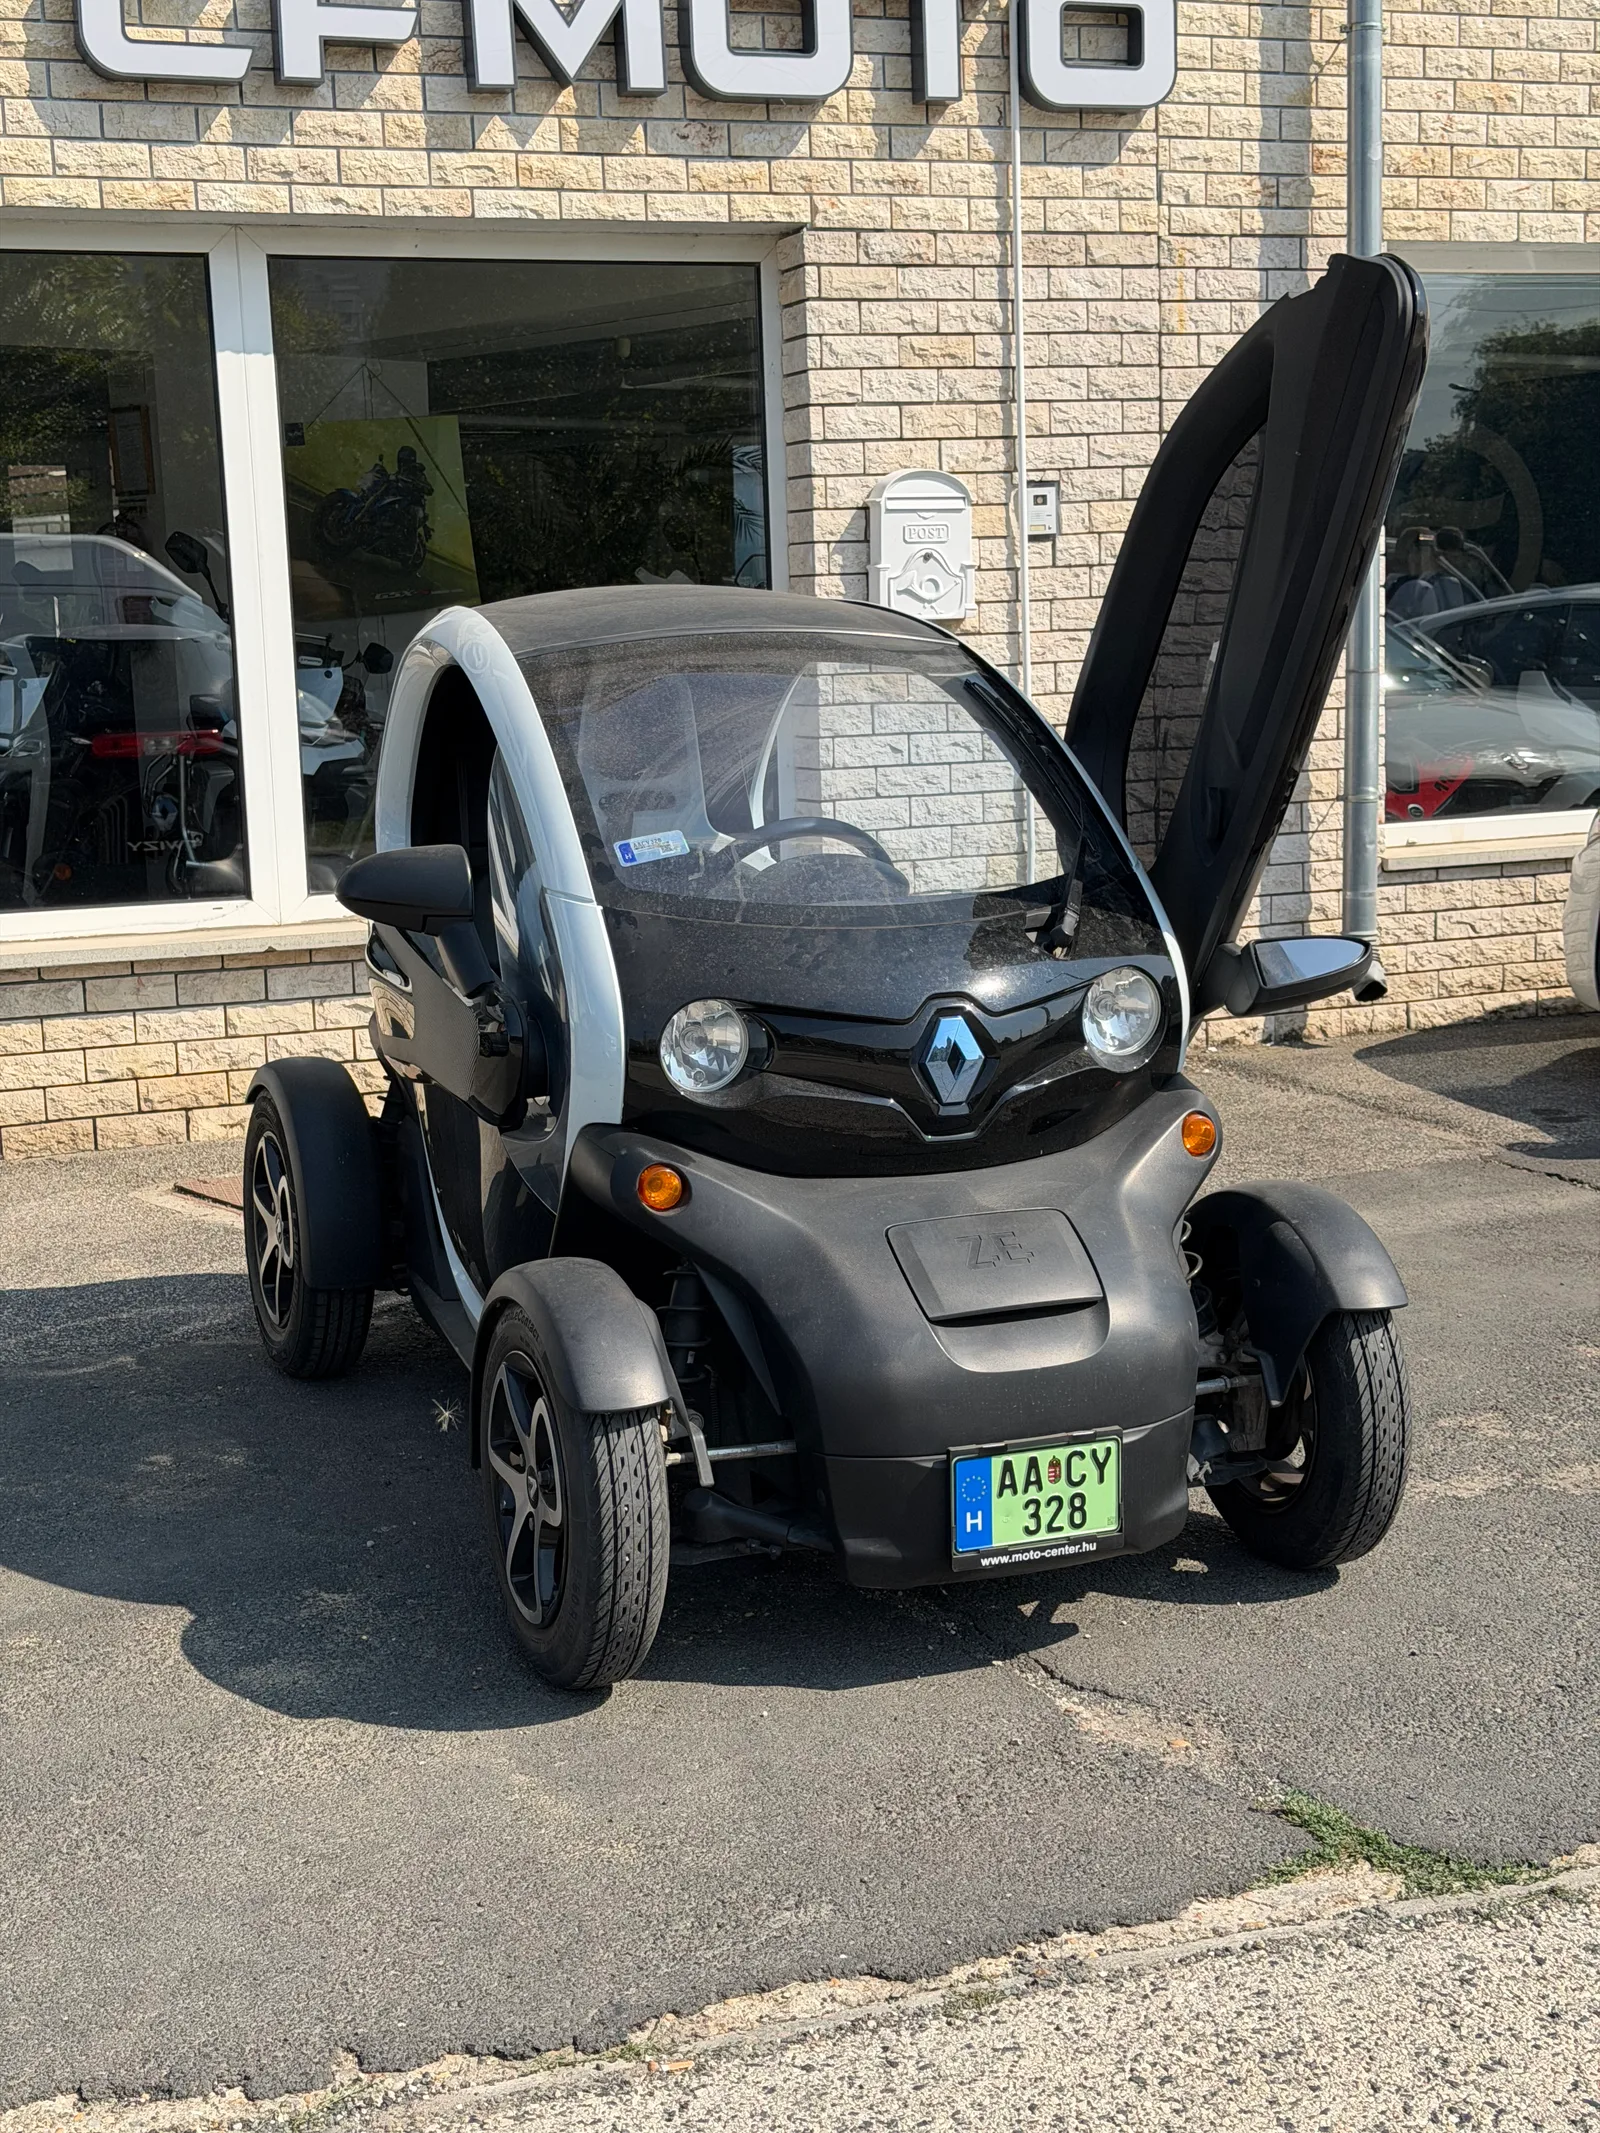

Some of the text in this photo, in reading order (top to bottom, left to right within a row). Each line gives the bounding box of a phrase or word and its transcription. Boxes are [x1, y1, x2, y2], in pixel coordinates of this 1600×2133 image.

[908, 527, 945, 540] POST
[965, 1510, 983, 1533] H
[1022, 1491, 1087, 1536] 328
[980, 1541, 1097, 1567] www.moto-center.hu
